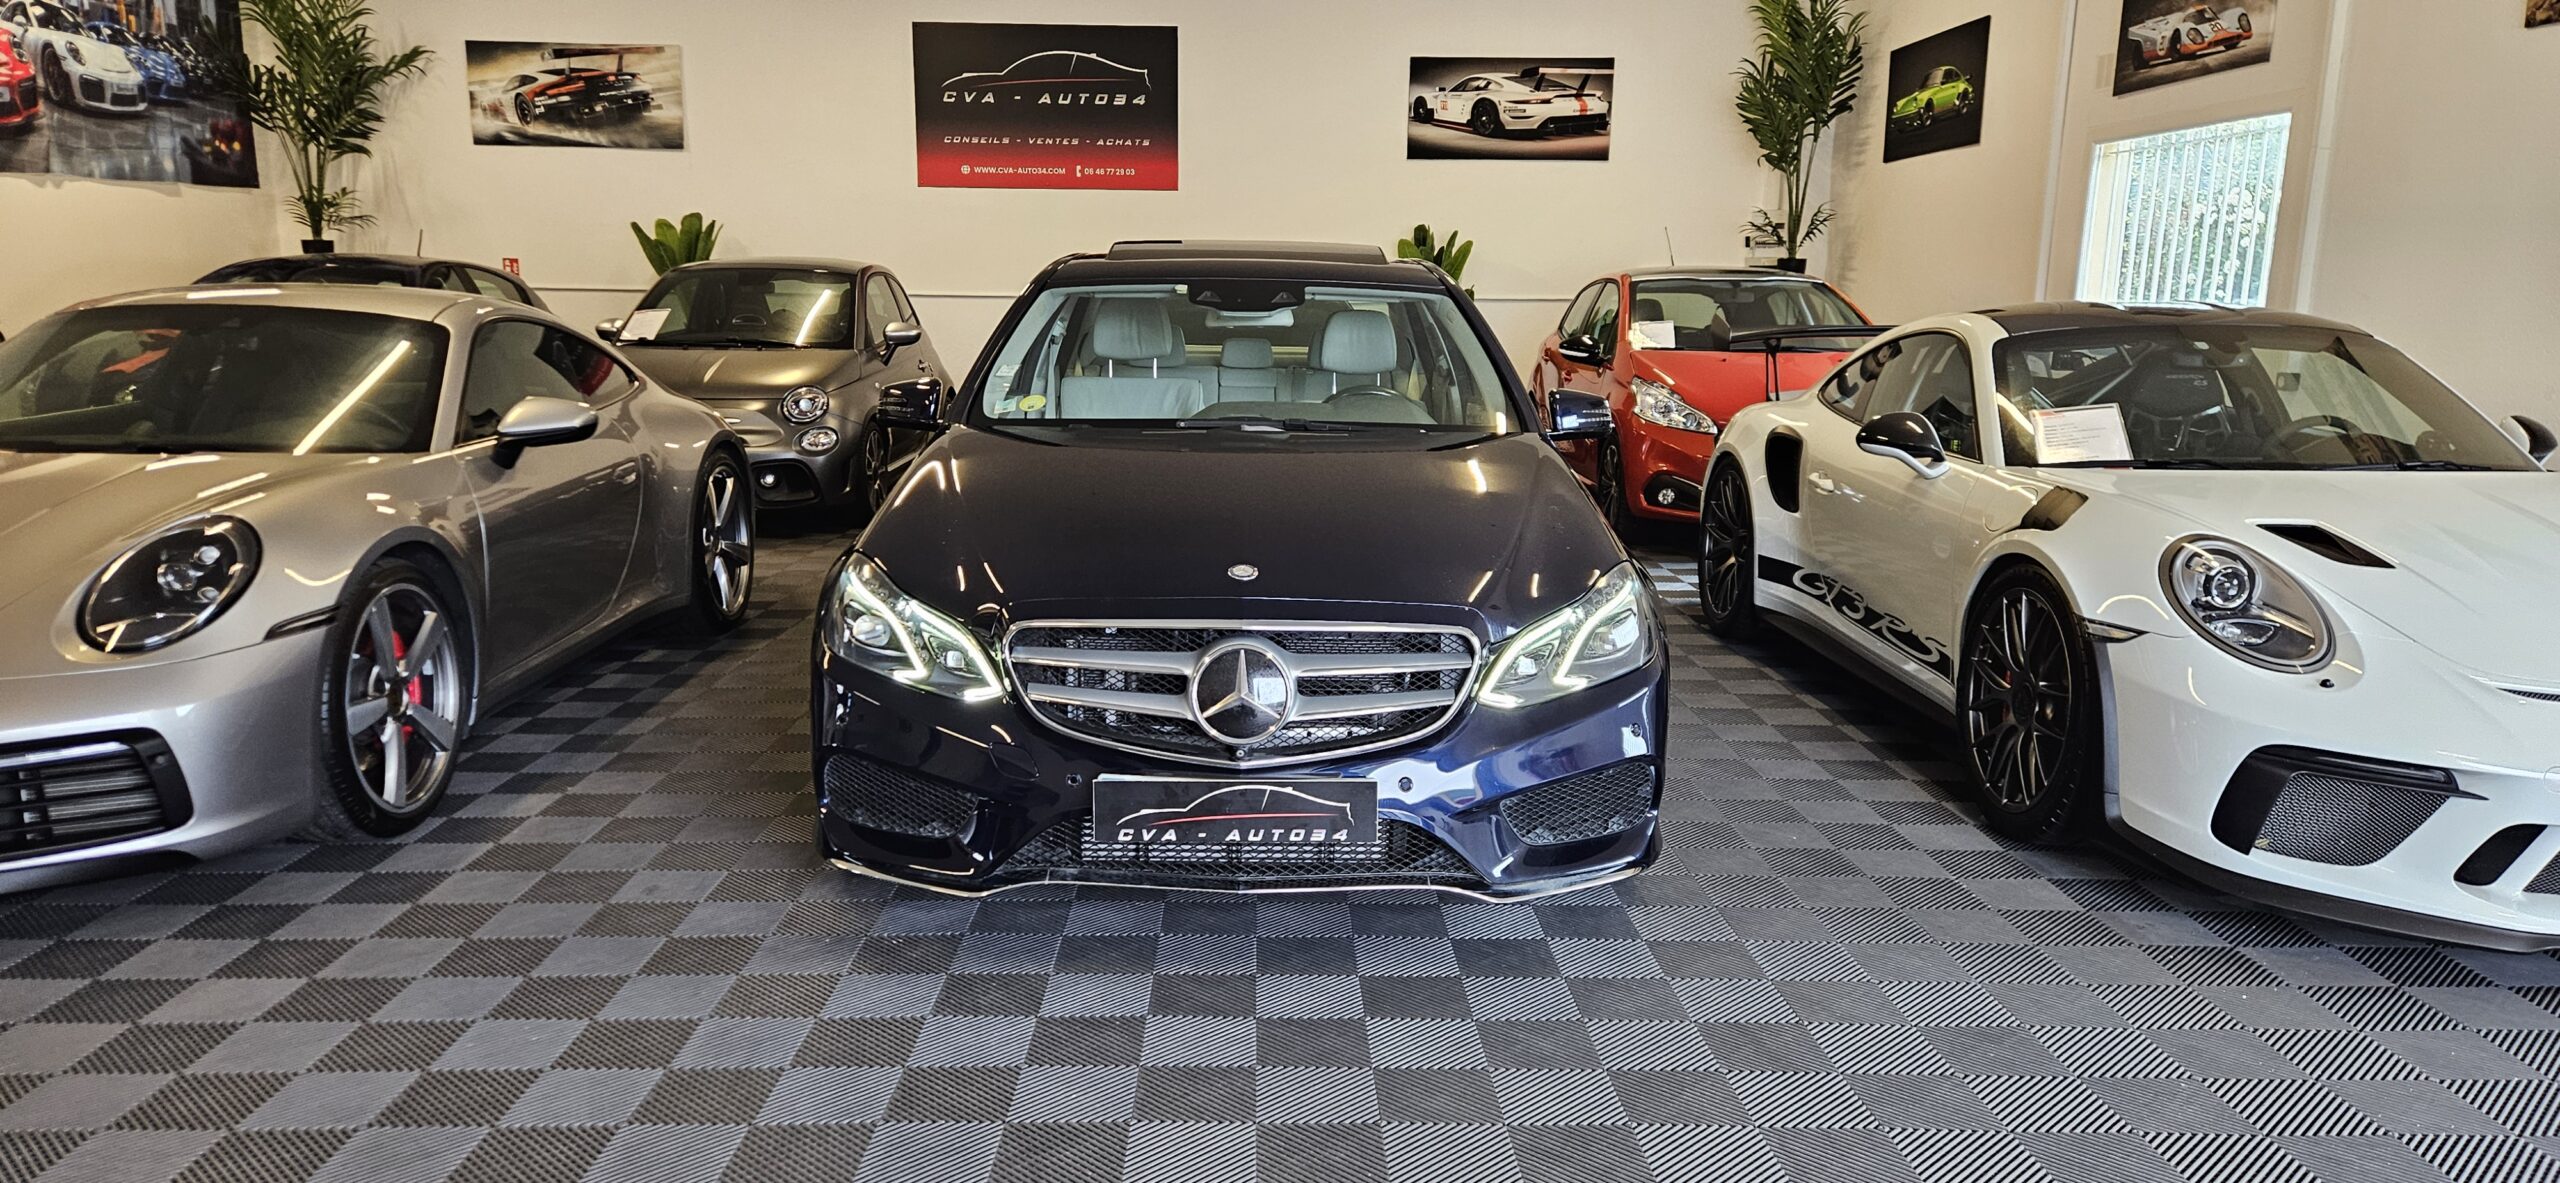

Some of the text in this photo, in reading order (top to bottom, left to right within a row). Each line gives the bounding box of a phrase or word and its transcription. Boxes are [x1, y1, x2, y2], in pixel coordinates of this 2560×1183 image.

[2209, 22, 2222, 32] 20
[943, 91, 995, 104] CVA
[1038, 92, 1147, 106] AUTO34
[944, 136, 1010, 144] CONSEILS
[1028, 137, 1080, 145] VENTES
[1096, 138, 1151, 146] ACHATS
[974, 166, 1066, 175] WWW.CVA-AUTO34.COM
[1125, 168, 1135, 176] 03
[1793, 568, 1947, 664] GT3 RS
[1117, 828, 1177, 842] CVA
[1225, 828, 1350, 842] AUTO34
